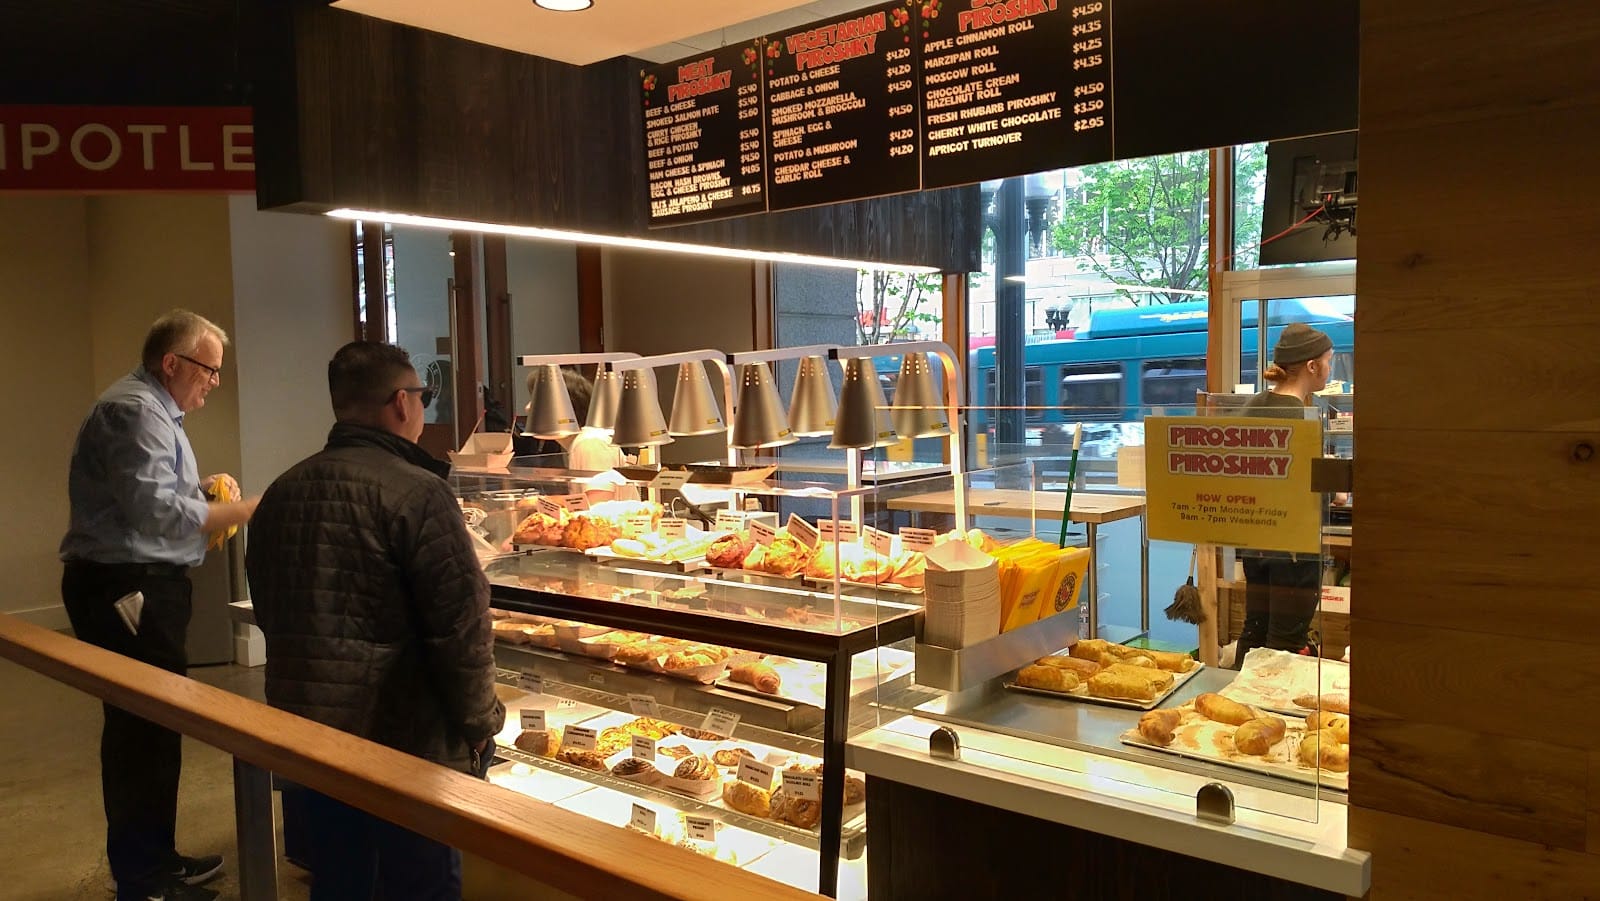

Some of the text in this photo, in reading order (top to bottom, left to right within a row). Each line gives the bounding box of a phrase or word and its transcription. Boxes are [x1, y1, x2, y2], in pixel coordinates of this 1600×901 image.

[1072, 2, 1102, 18] $4.50
[786, 11, 886, 54] VEGETARIAN
[1072, 20, 1101, 36] $4.35
[924, 20, 1034, 53] APPLE CINNAMON ROLL
[796, 34, 876, 71] PIROSHKY
[1073, 38, 1102, 54] $4.25
[886, 48, 910, 61] $4.20
[925, 45, 999, 69] MARZIPAN ROLL
[1073, 55, 1102, 70] $4.35
[678, 57, 714, 82] MEAT
[769, 65, 840, 88] POTATO & CHEESE
[887, 65, 911, 78] $4.20
[926, 62, 997, 85] MOSCOW ROLL
[668, 70, 732, 102] PIROSHKY
[771, 80, 839, 103] CABBAGE & ONION
[888, 80, 912, 93] $4.50
[926, 73, 1020, 100] CHOCOLATE CREAM
[1074, 82, 1104, 97] $4.50
[927, 88, 1002, 109] HAZELNUT ROLL
[646, 107, 662, 118] BEEF
[670, 99, 696, 112] CHEESE
[772, 104, 803, 118] SMOKED
[818, 108, 824, 117] &
[825, 98, 866, 115] BROCCOLI
[889, 104, 913, 118] $4.50
[928, 92, 1056, 125] FRESH RHUBARB PIROSHKY
[1074, 100, 1104, 115] $3.50
[647, 105, 719, 128] SMOKED SALMON PATE
[928, 108, 1062, 140] CHERRY WHITE CHOCOLATE
[1074, 116, 1104, 132] $2.95
[648, 122, 698, 139] CURRY CHICKEN
[808, 122, 825, 133] EGG
[826, 121, 832, 129] &
[889, 129, 913, 141] $4.20
[654, 136, 669, 145] RICE
[671, 129, 702, 142] PIROSHKY
[773, 135, 802, 147] CHEESE
[929, 132, 1022, 156] APRICOT TURNOVER
[648, 148, 665, 158] BEEF
[673, 141, 698, 153] POTATO
[774, 140, 857, 162] POTATO & MUSHROOM
[890, 144, 914, 157] $4.20
[649, 154, 693, 169] BEEF & ONION
[665, 166, 690, 177] CHEESE
[698, 159, 725, 171] SPINACH
[775, 155, 850, 175] CHEDDAR CHEESE &
[675, 177, 692, 186] HASH
[775, 170, 822, 184] GARLIC ROLL
[673, 184, 698, 195] CHEESE
[700, 177, 730, 190] PIROSHKY
[708, 189, 733, 201] CHEESE
[652, 201, 712, 217] SAUSAGE PIROSHKY
[1169, 425, 1291, 449] PIROSHKY
[1169, 452, 1291, 478] PIROSHKY
[1196, 493, 1255, 504] NOW OPEN
[1198, 504, 1216, 513] 7pm
[1220, 505, 1288, 518] Monday-Friday
[1181, 513, 1198, 521] 9am
[1208, 515, 1226, 523] 7pm
[1230, 516, 1277, 526] Weekends
